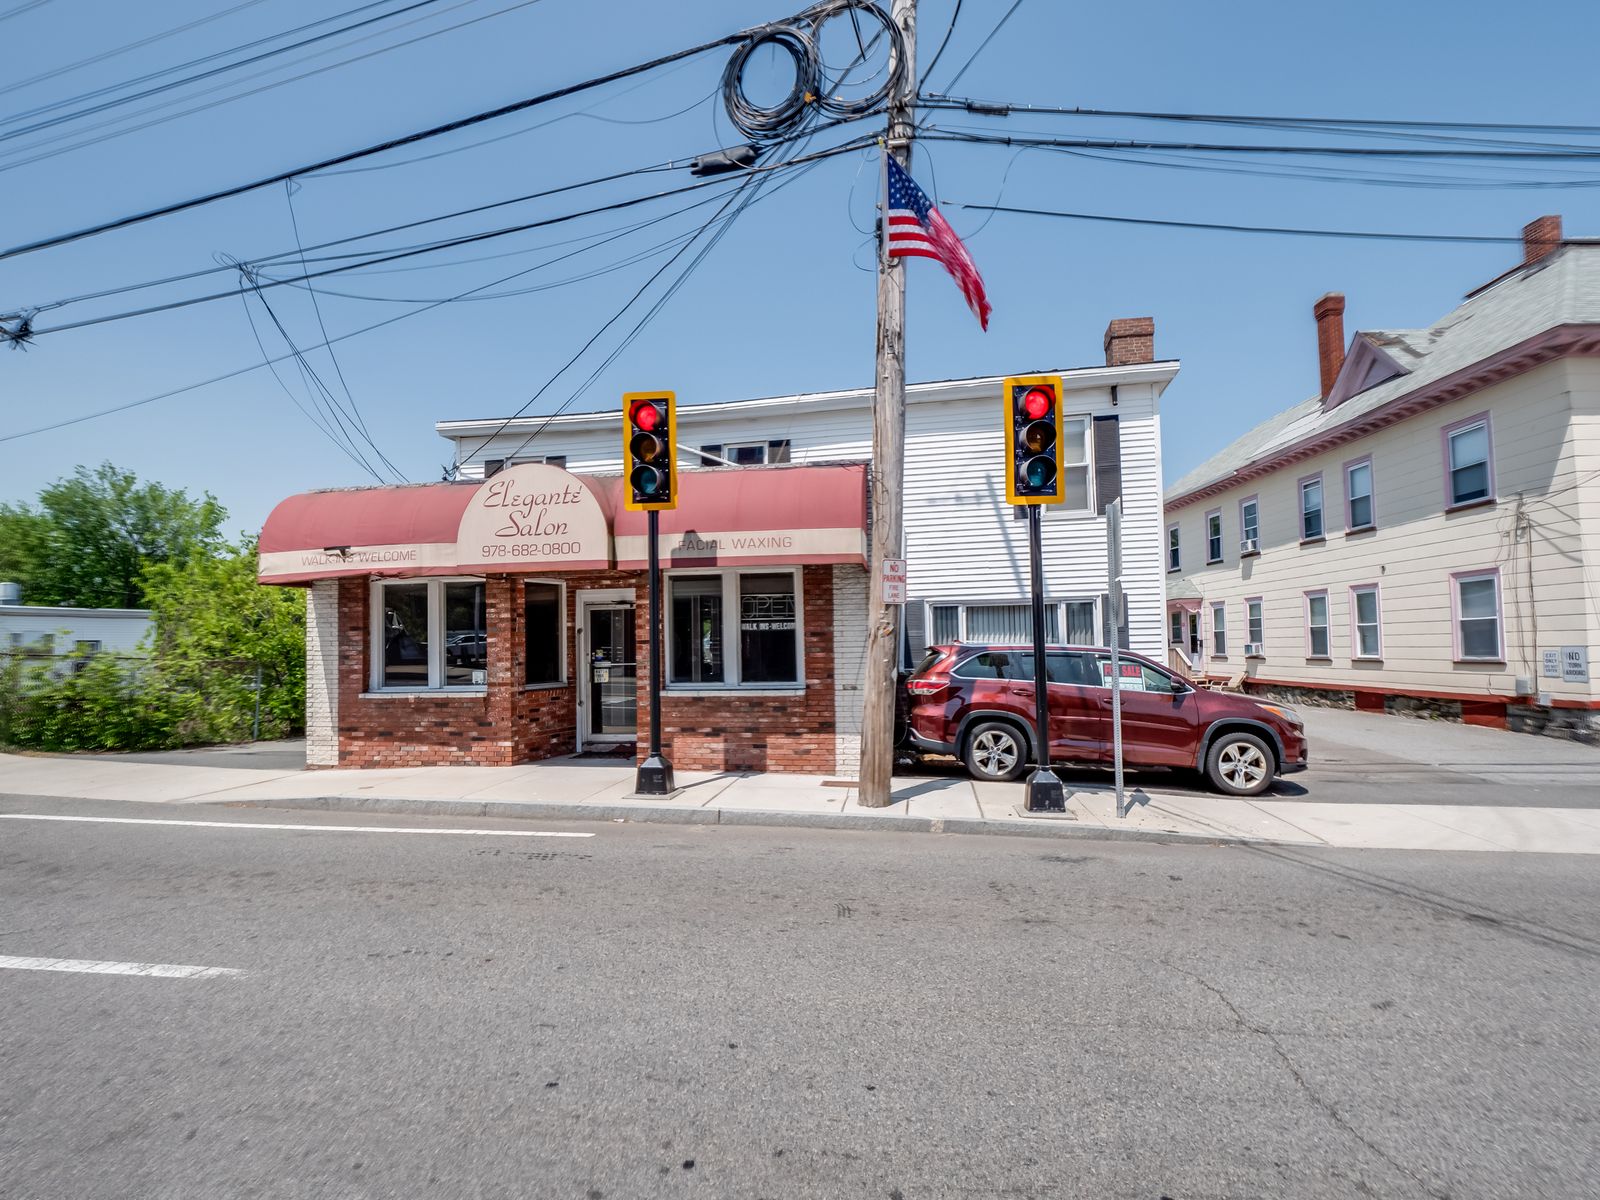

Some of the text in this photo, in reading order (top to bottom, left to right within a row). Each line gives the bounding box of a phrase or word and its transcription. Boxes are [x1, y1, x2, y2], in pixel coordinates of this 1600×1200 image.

[495, 507, 568, 537] Salon
[482, 541, 581, 557] 978-682-0800
[678, 536, 792, 551] FACIAL WAXING
[359, 550, 417, 563] WELCOME
[889, 564, 899, 573] NO
[883, 574, 906, 583] PARKING
[1568, 652, 1580, 661] NO
[1121, 665, 1140, 677] SALE
